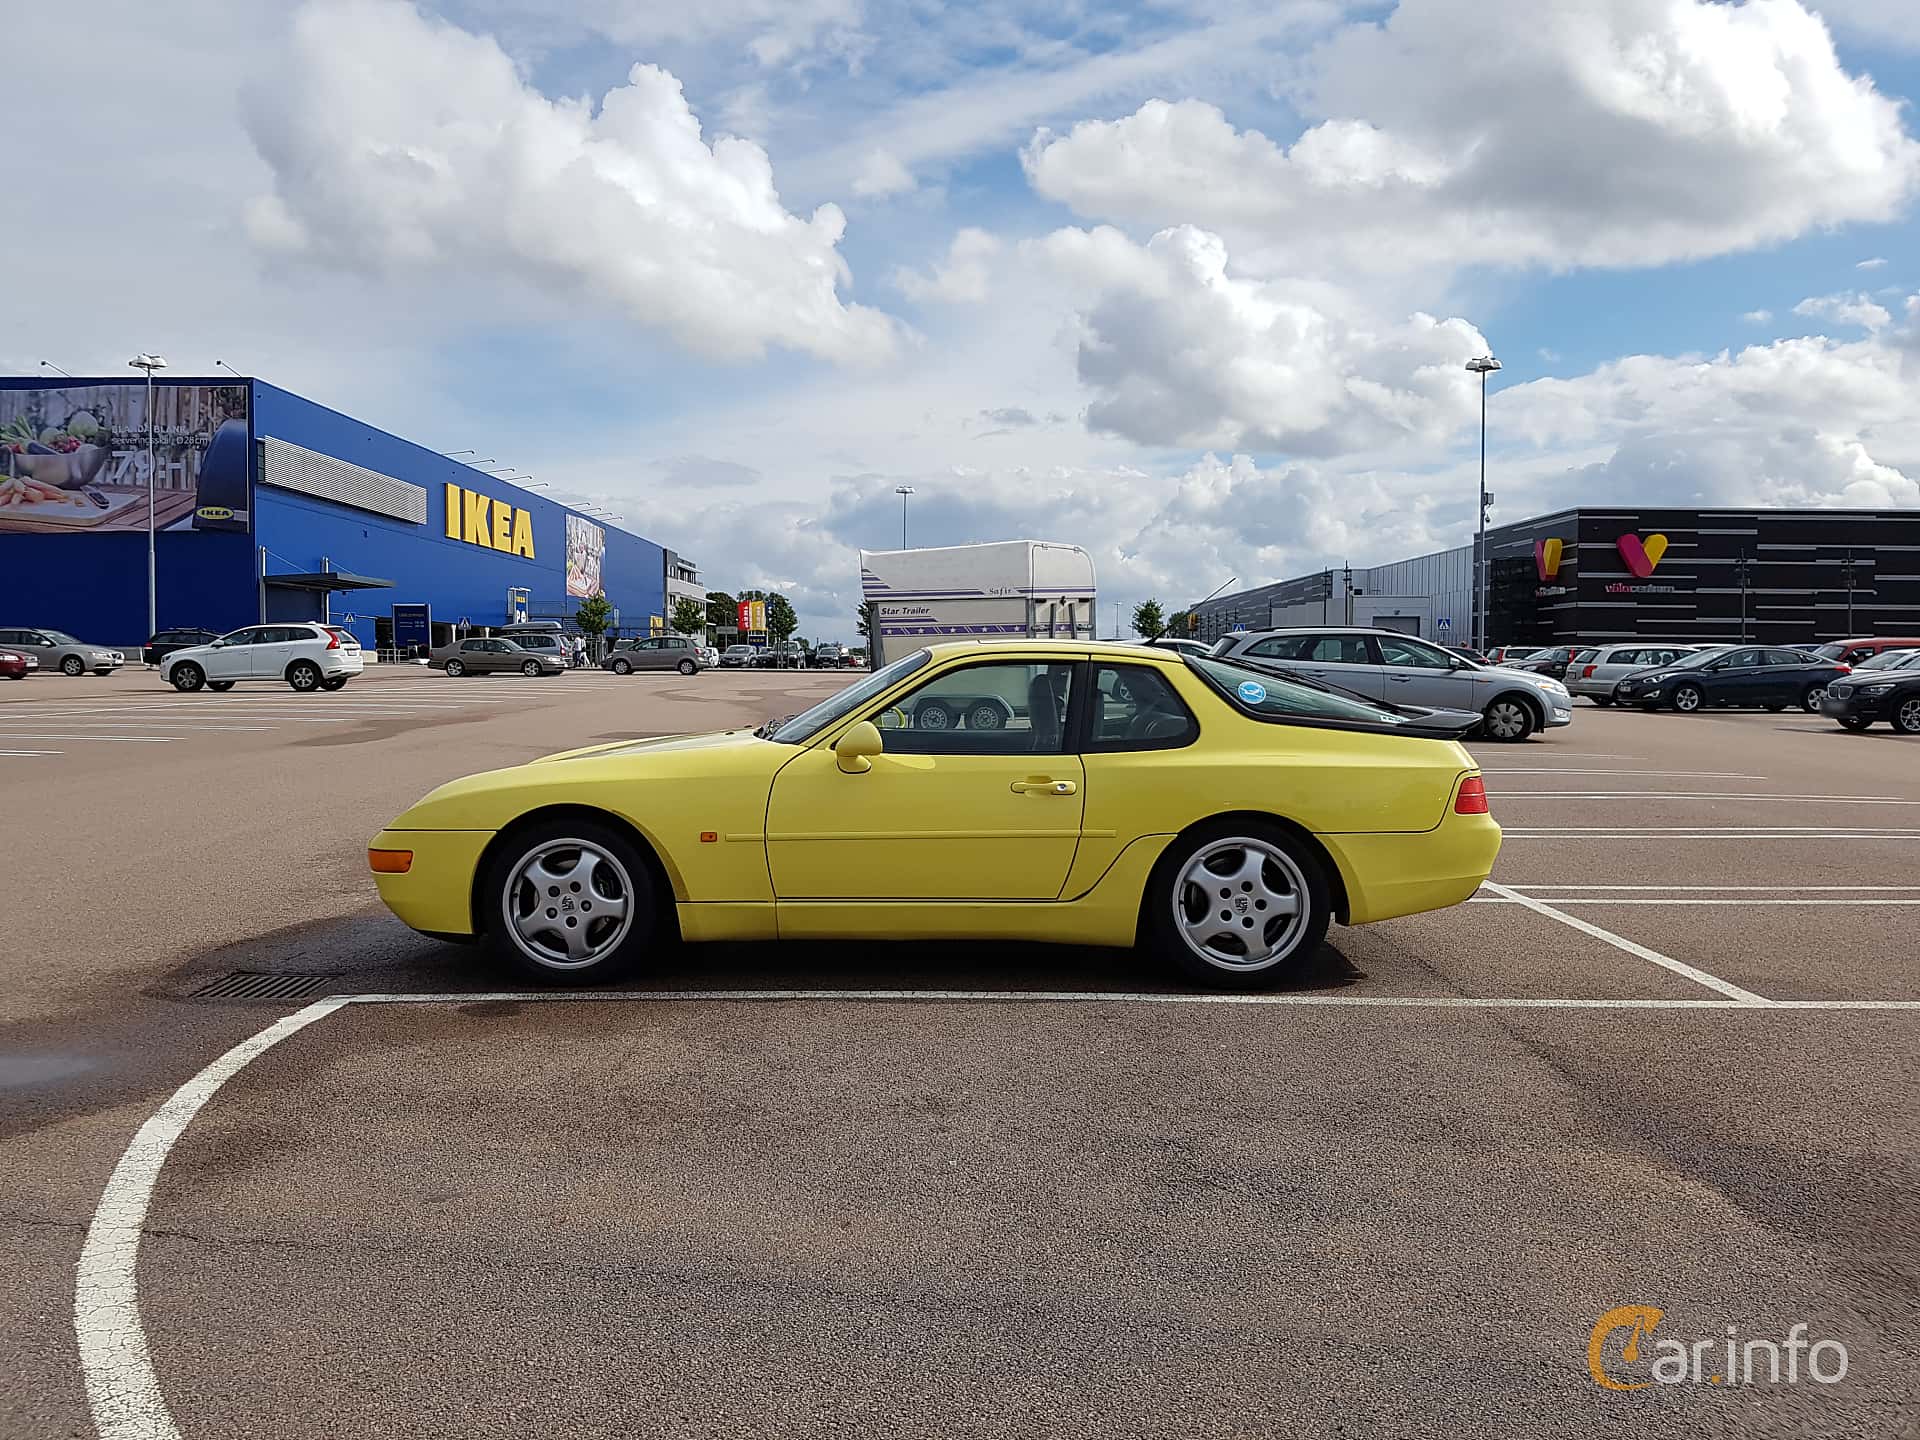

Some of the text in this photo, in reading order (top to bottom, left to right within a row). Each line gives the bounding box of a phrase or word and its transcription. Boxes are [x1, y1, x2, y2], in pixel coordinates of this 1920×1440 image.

[445, 483, 535, 559] IKEA
[881, 606, 930, 615] Star Trailer
